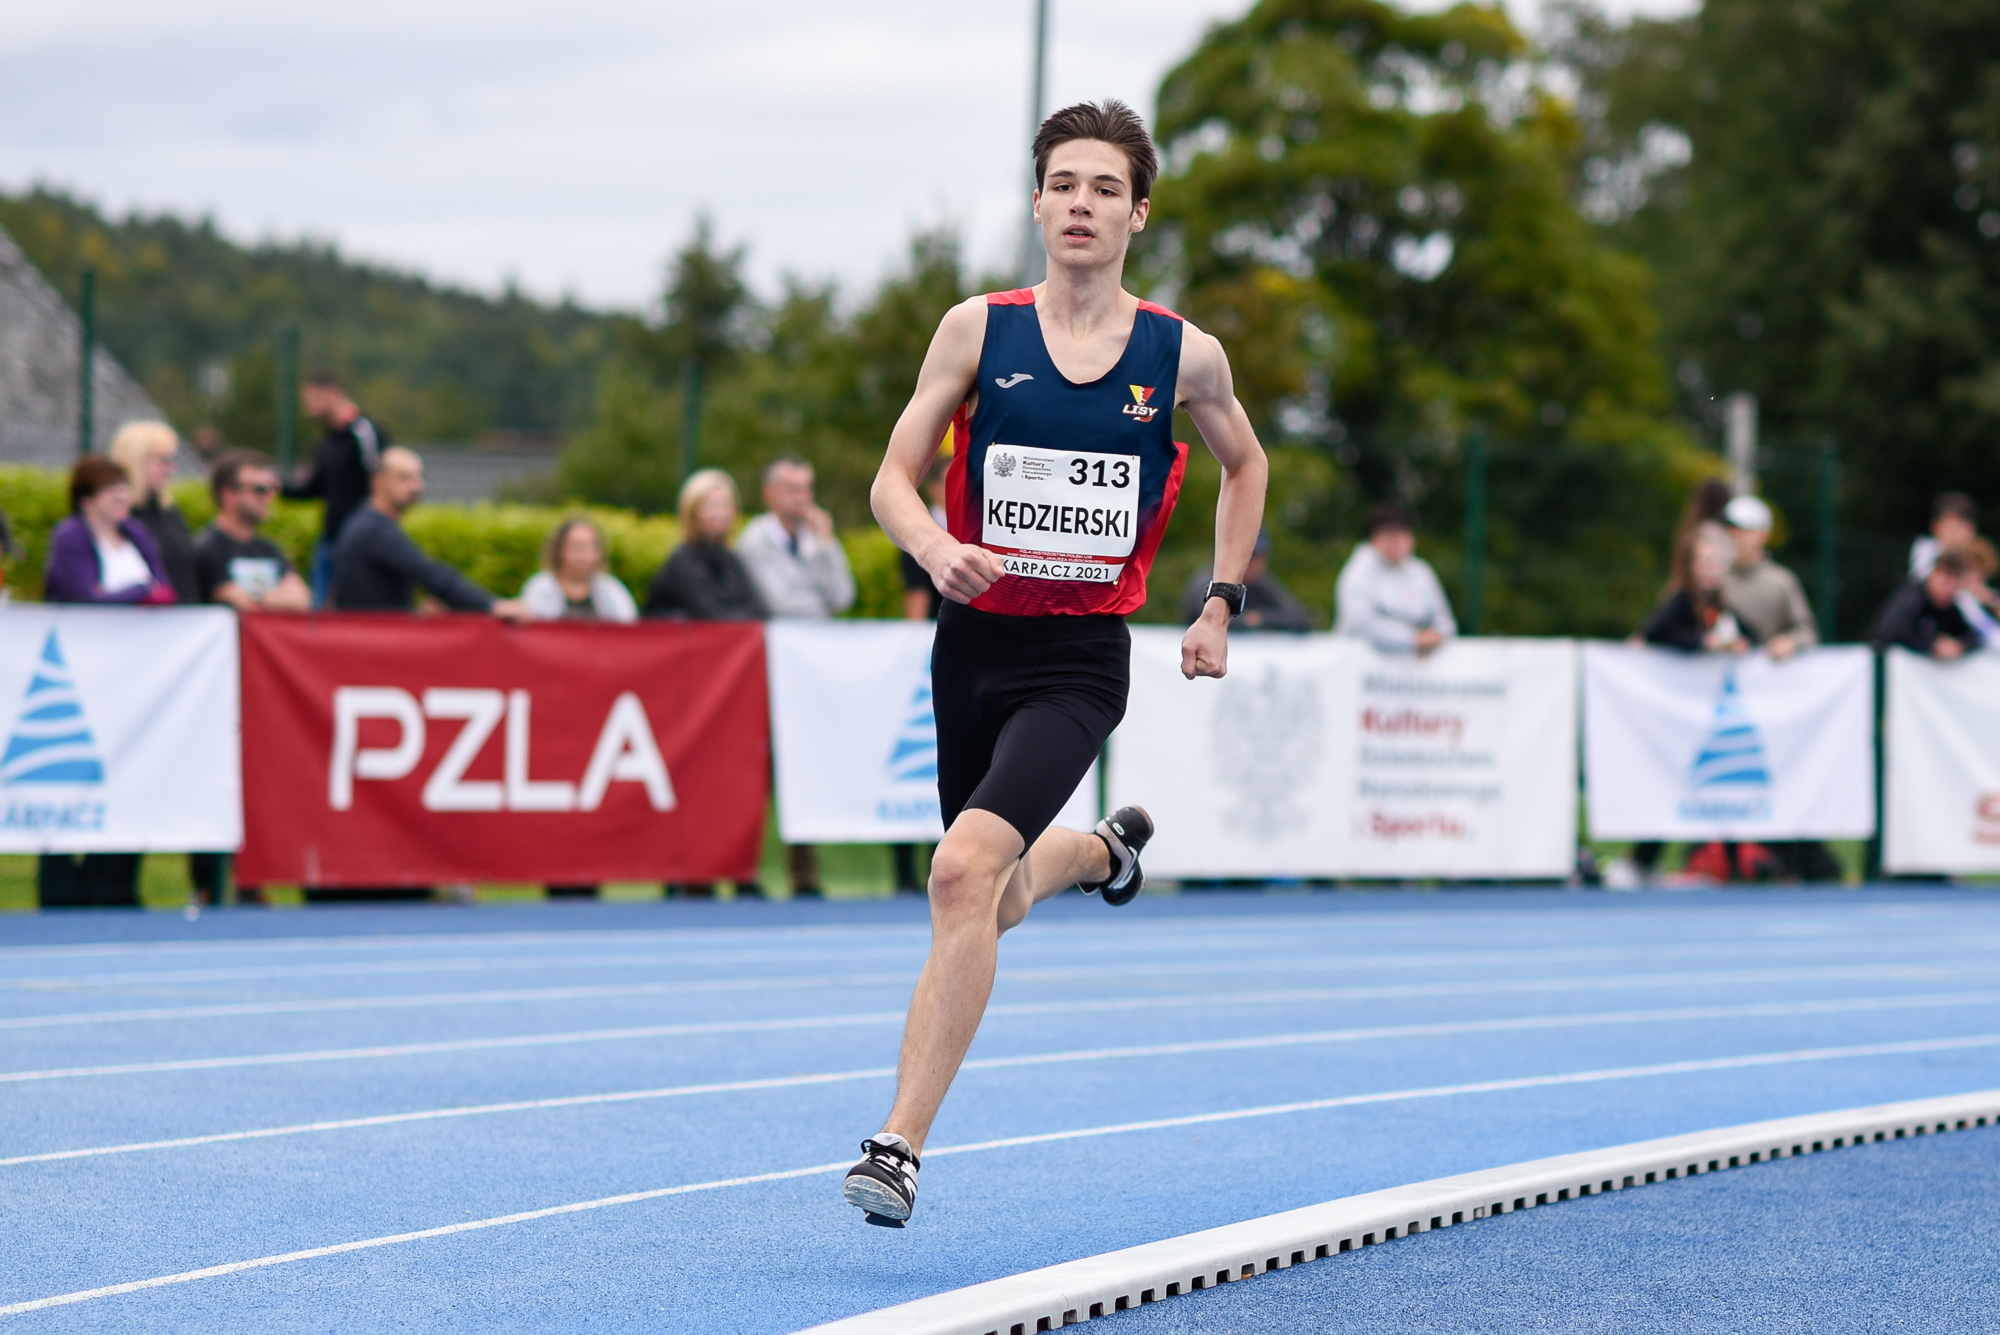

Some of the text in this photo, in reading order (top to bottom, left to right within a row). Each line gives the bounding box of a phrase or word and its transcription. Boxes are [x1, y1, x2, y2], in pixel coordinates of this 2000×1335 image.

[1122, 404, 1158, 417] LISY
[1023, 460, 1046, 468] Kultury
[1068, 458, 1130, 489] 313
[988, 498, 1130, 538] KĘDZIERSKI
[1003, 559, 1109, 579] KARPACZ 2021
[329, 686, 677, 811] PZLA
[0, 802, 106, 832] ARPACZ
